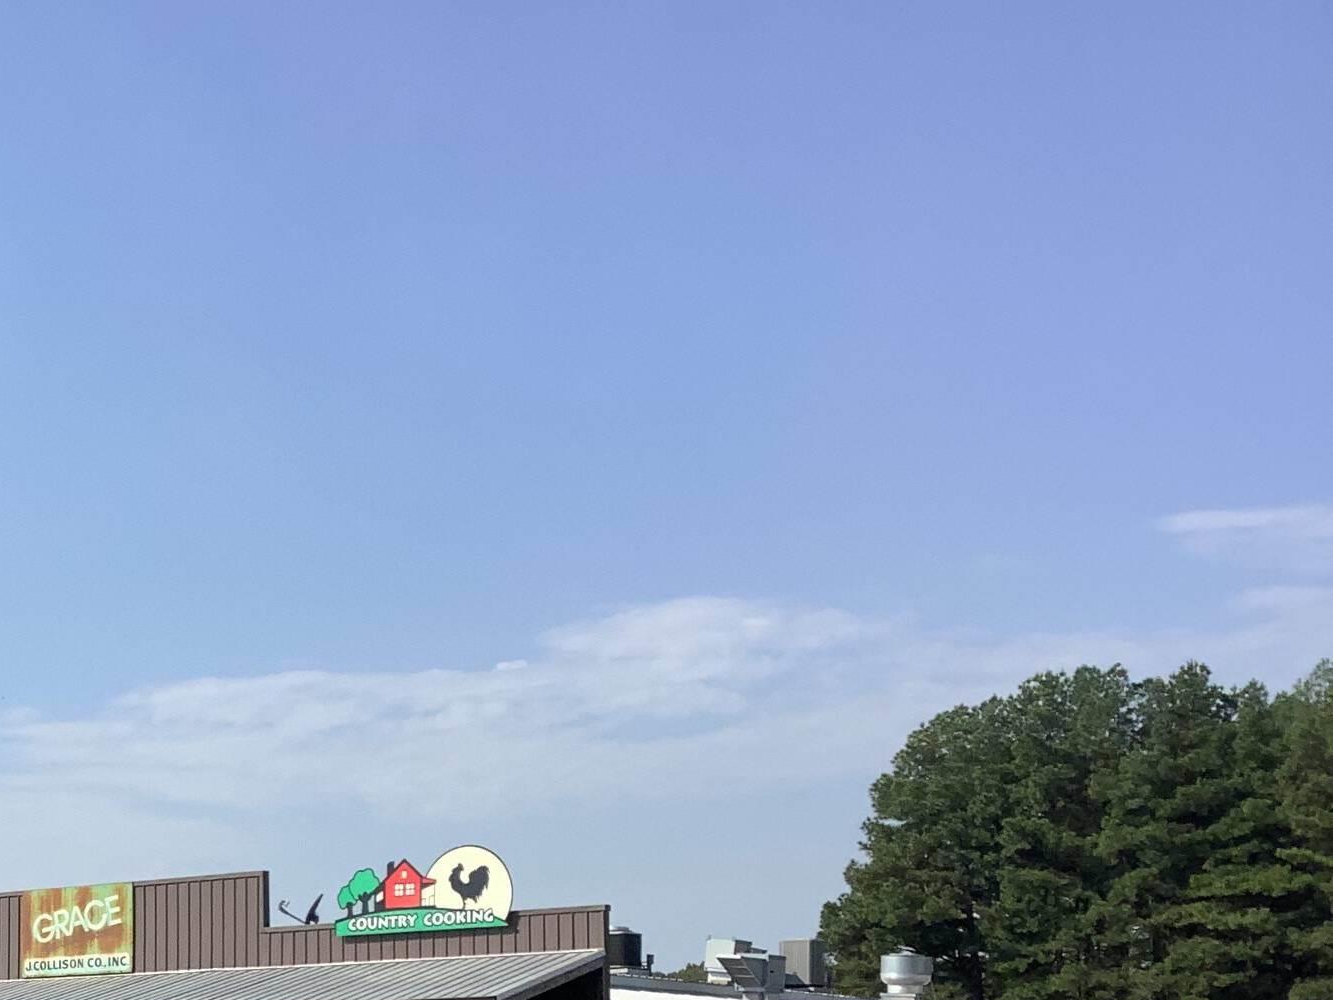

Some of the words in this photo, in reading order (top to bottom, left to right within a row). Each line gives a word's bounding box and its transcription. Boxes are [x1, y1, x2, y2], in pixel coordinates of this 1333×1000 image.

[32, 894, 122, 943] GRACE
[348, 914, 417, 931] COUNTRY
[423, 909, 494, 927] COOKING
